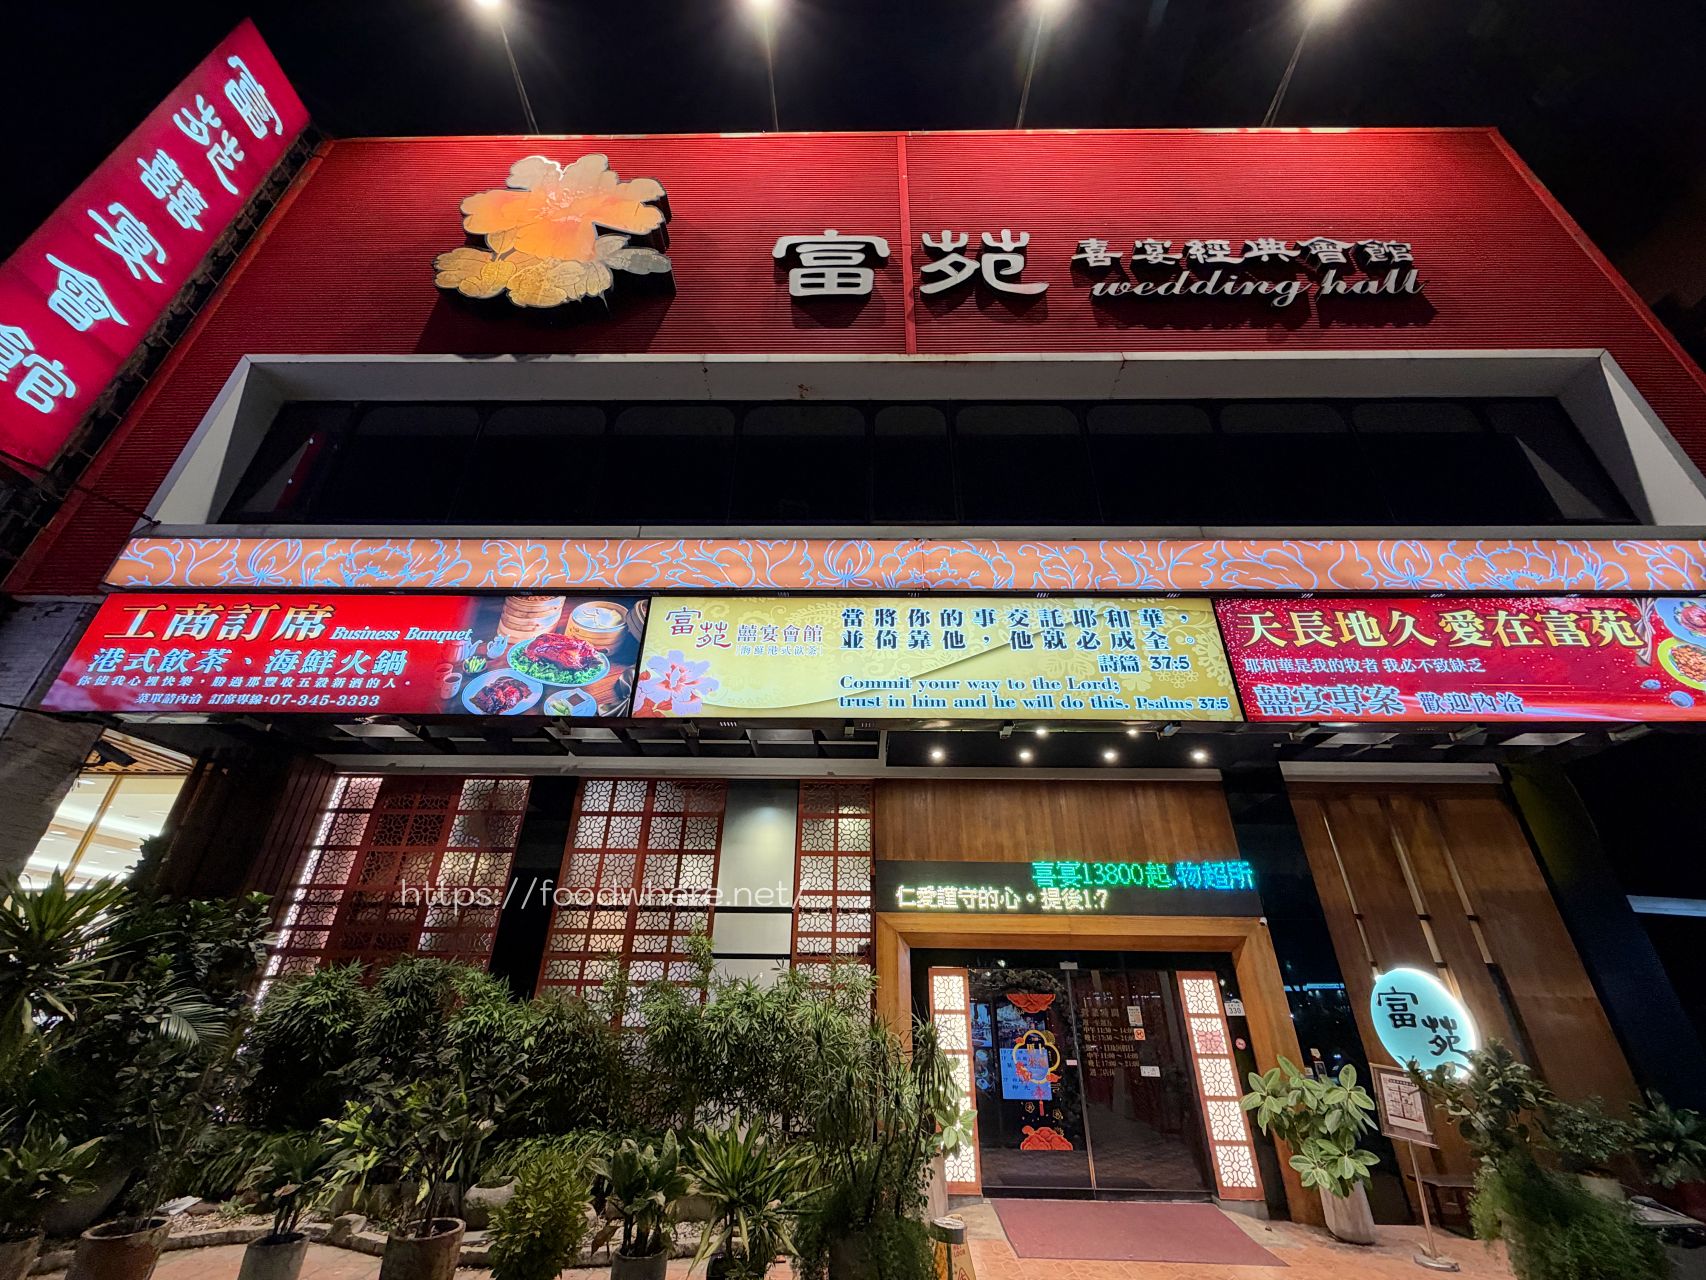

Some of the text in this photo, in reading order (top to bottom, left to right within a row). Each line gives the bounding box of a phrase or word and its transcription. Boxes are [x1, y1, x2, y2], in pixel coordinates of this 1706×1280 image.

[771, 229, 1049, 298] 富苑
[1072, 236, 1414, 267] 喜宴經典會館
[1091, 268, 1424, 307] wedding hall
[103, 603, 335, 642] 工商訂席
[329, 625, 472, 645] Business Banquet
[665, 607, 733, 648] 富苑
[737, 624, 823, 643] 囍宴會館
[1237, 611, 1644, 649] 天長地久 愛在富苑
[86, 647, 409, 676] 港式飲茶、海鮮火鍋
[1098, 655, 1191, 673] 詩篇 37:5
[1244, 658, 1378, 673] 耶和華是我的牧者
[839, 675, 1120, 693] Commit your way to the Lord;
[839, 694, 1230, 710] trust in him and he will do this. Psalms 37:5
[1377, 986, 1474, 1057] 富苑
